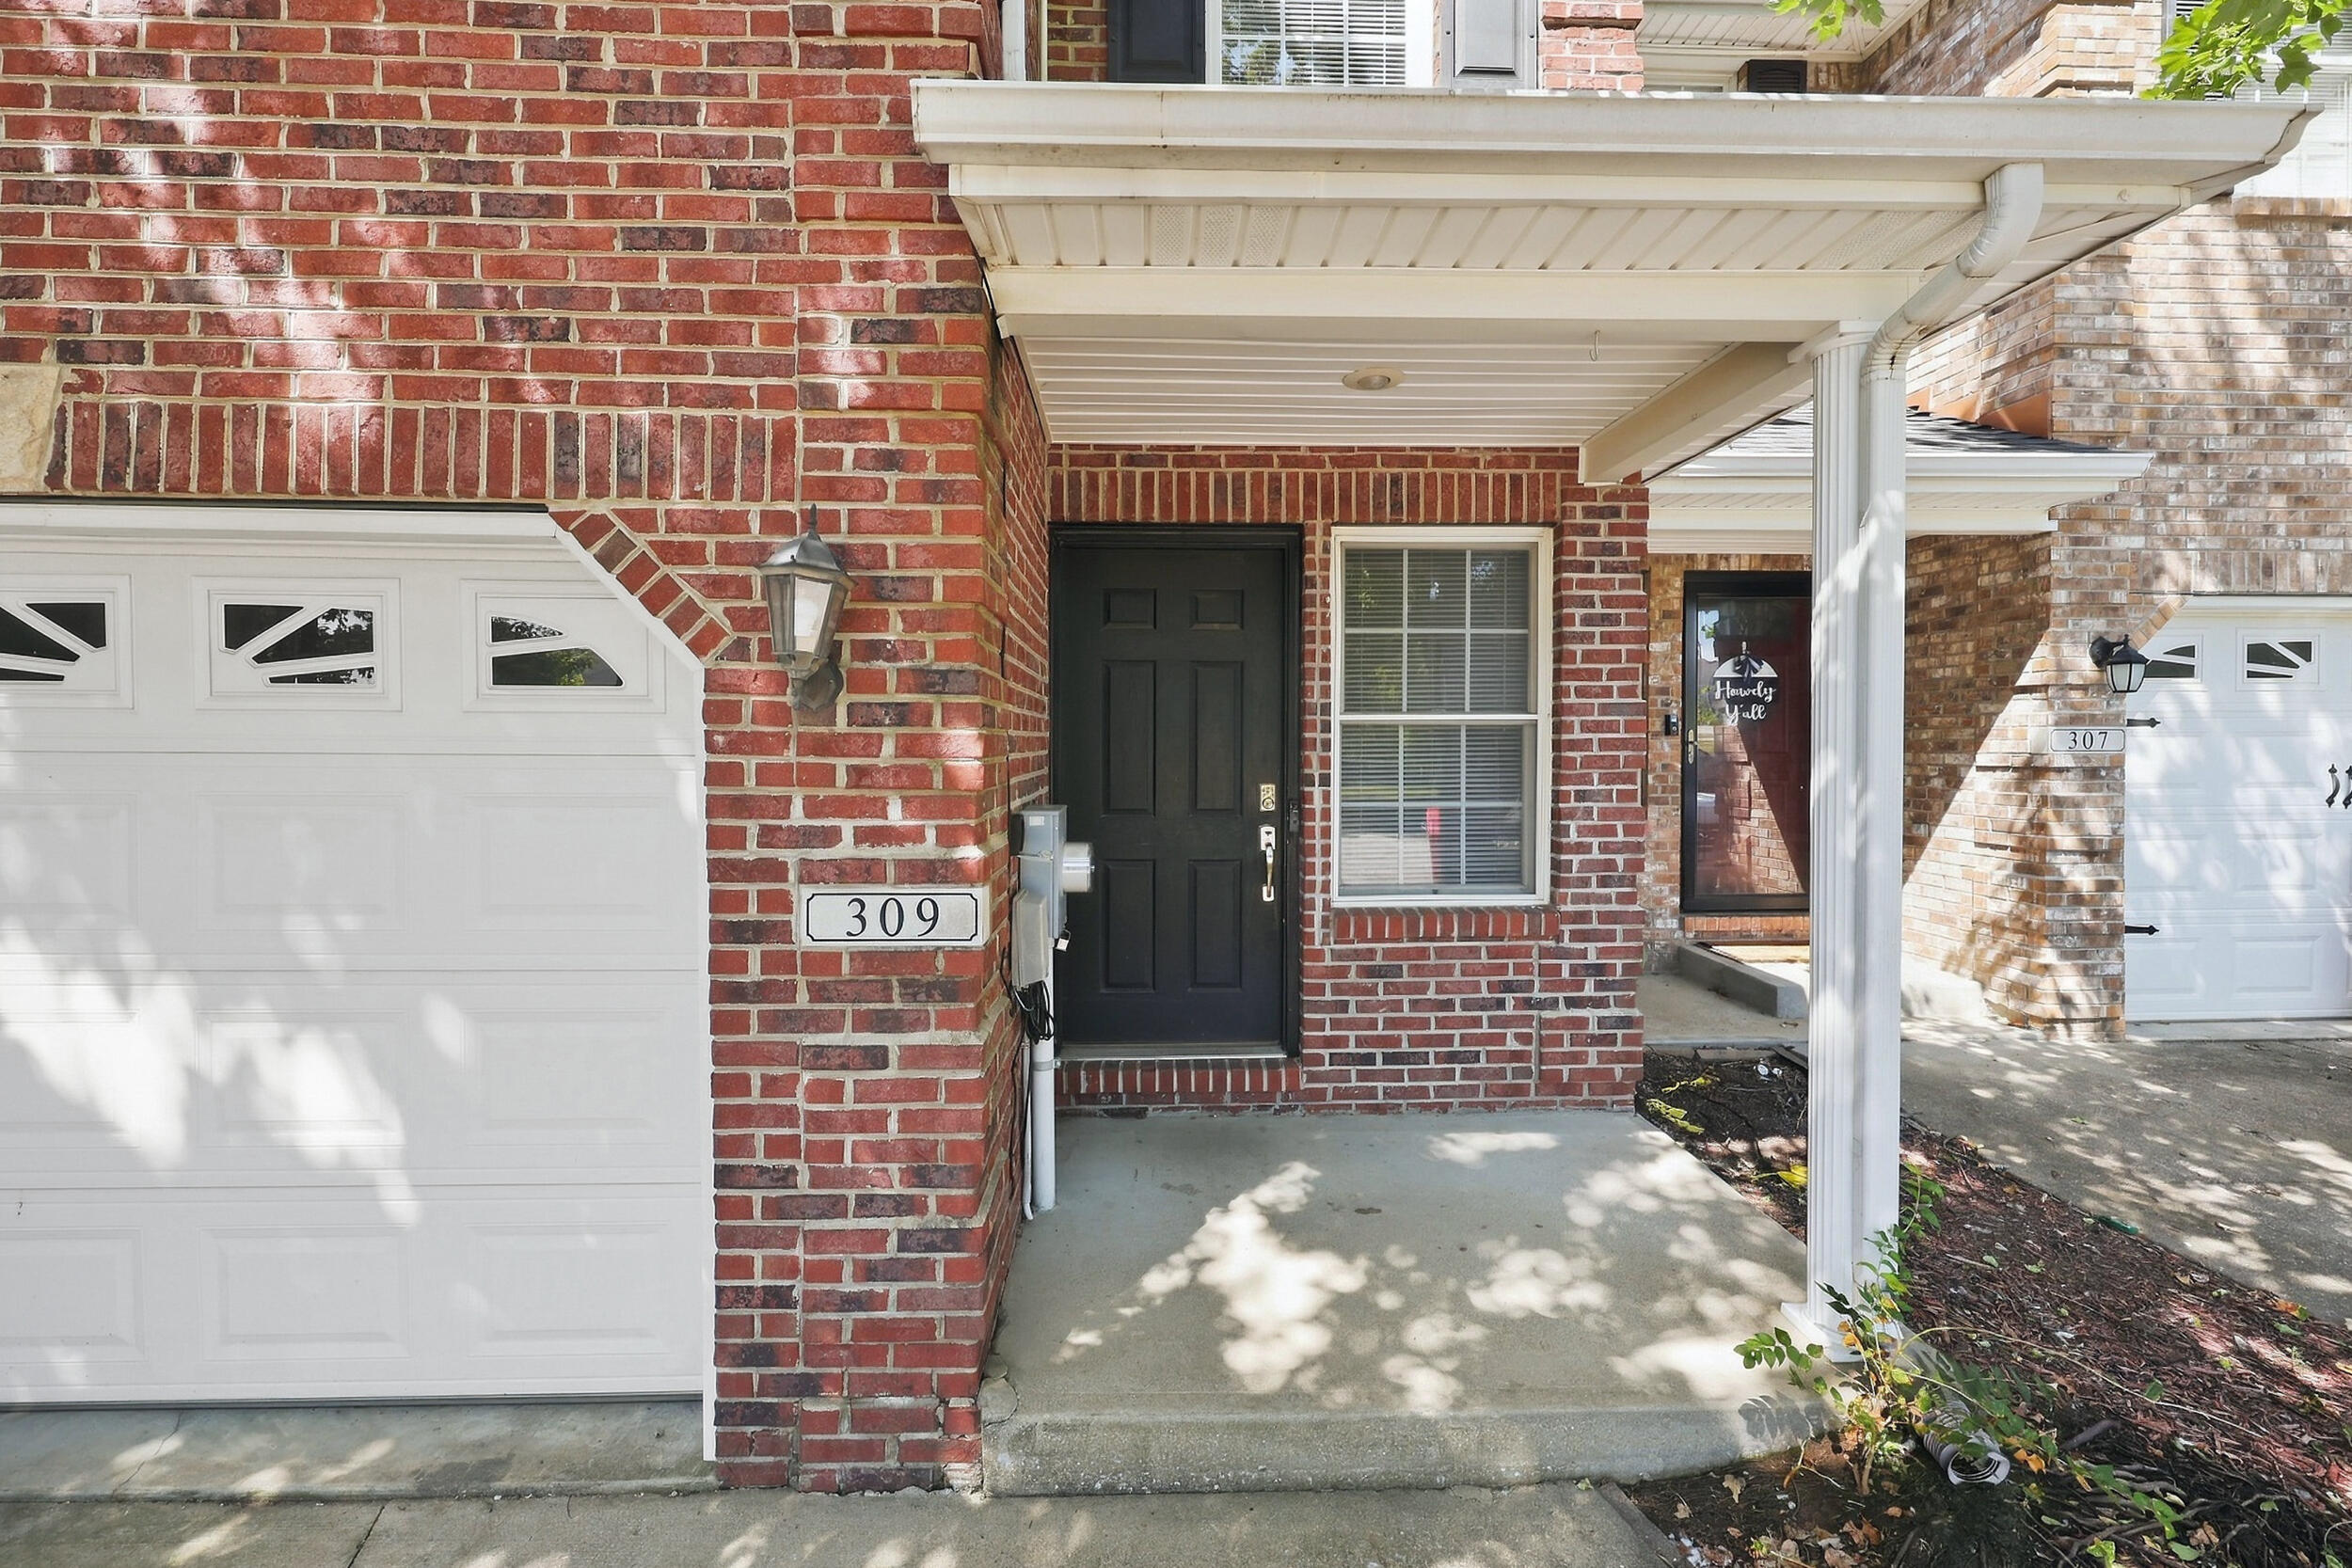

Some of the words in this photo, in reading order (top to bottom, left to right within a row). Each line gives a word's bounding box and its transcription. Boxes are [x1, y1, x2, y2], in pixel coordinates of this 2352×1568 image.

[1715, 680, 1776, 702] Howdy
[2068, 731, 2108, 750] 307
[846, 897, 939, 937] 309
